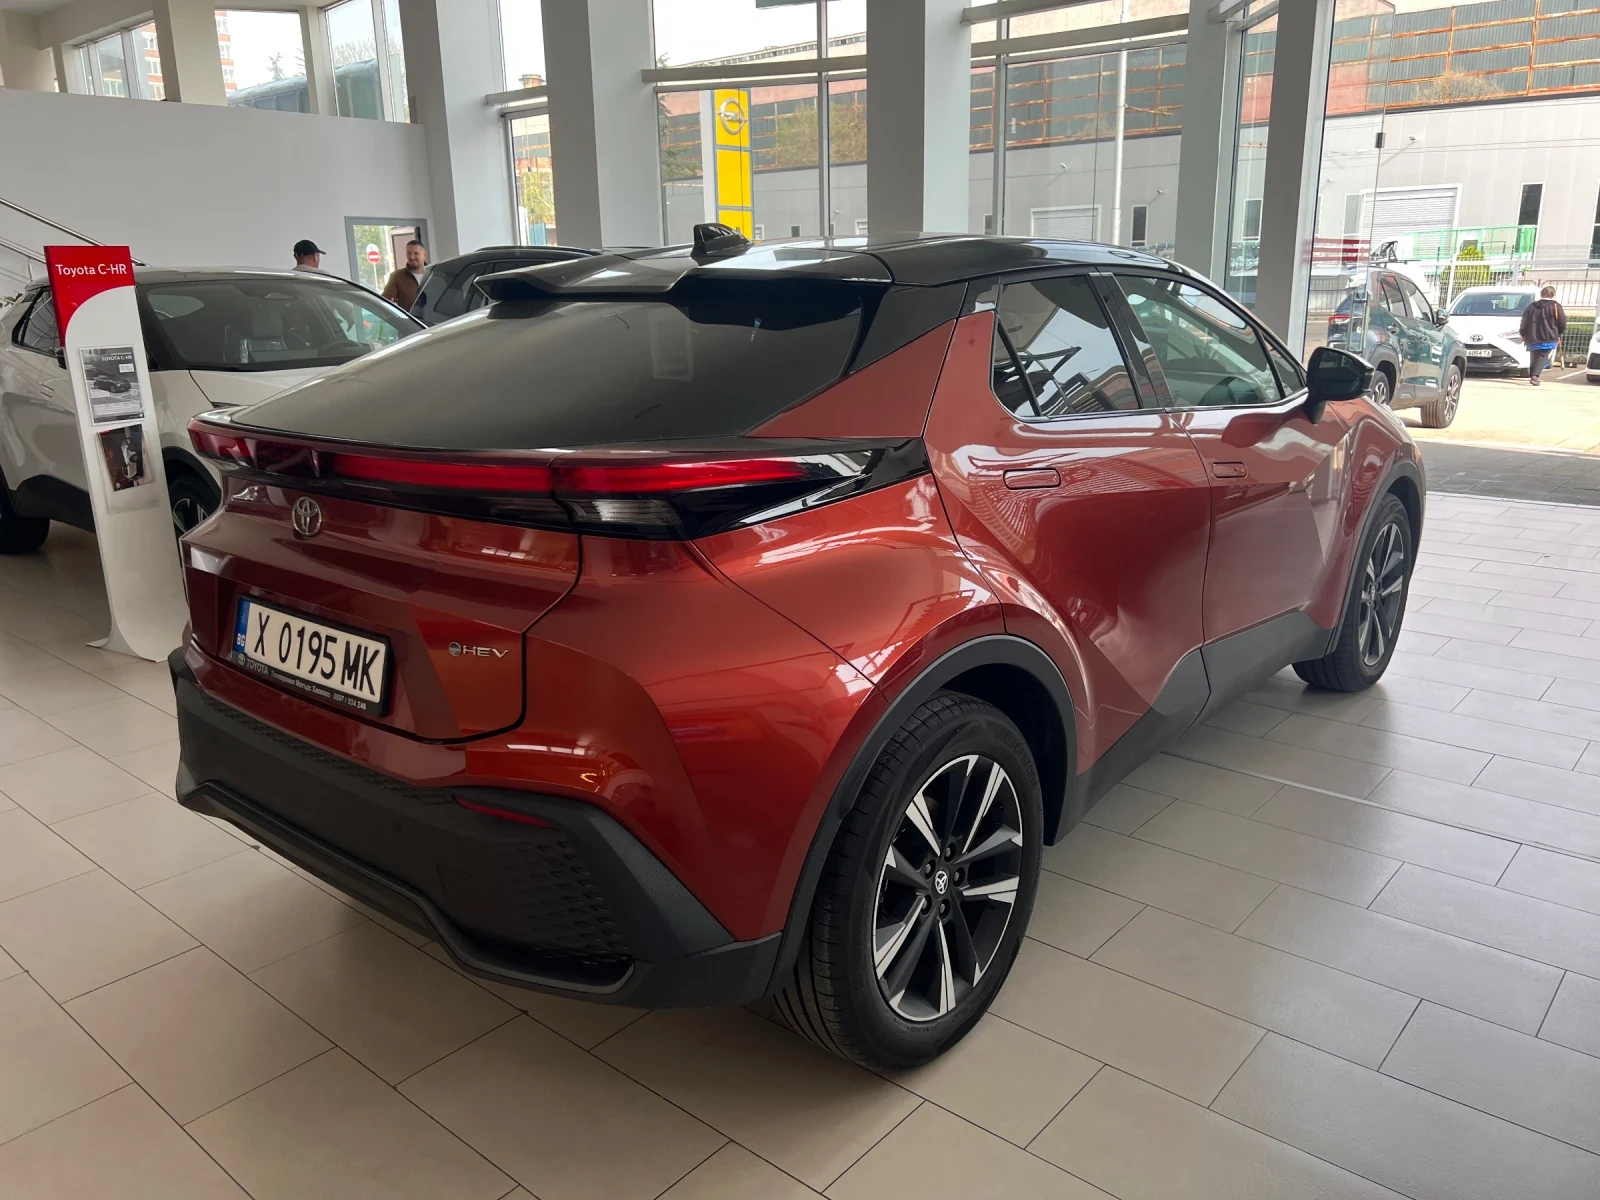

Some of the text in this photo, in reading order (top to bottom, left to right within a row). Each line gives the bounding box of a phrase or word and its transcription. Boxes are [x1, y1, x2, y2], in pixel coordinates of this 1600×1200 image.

[55, 263, 128, 278] Toyota C-HR
[236, 633, 245, 647] BG
[253, 612, 380, 696] X 0195 MK
[463, 645, 510, 659] HEV
[246, 657, 269, 676] TOYOTA
